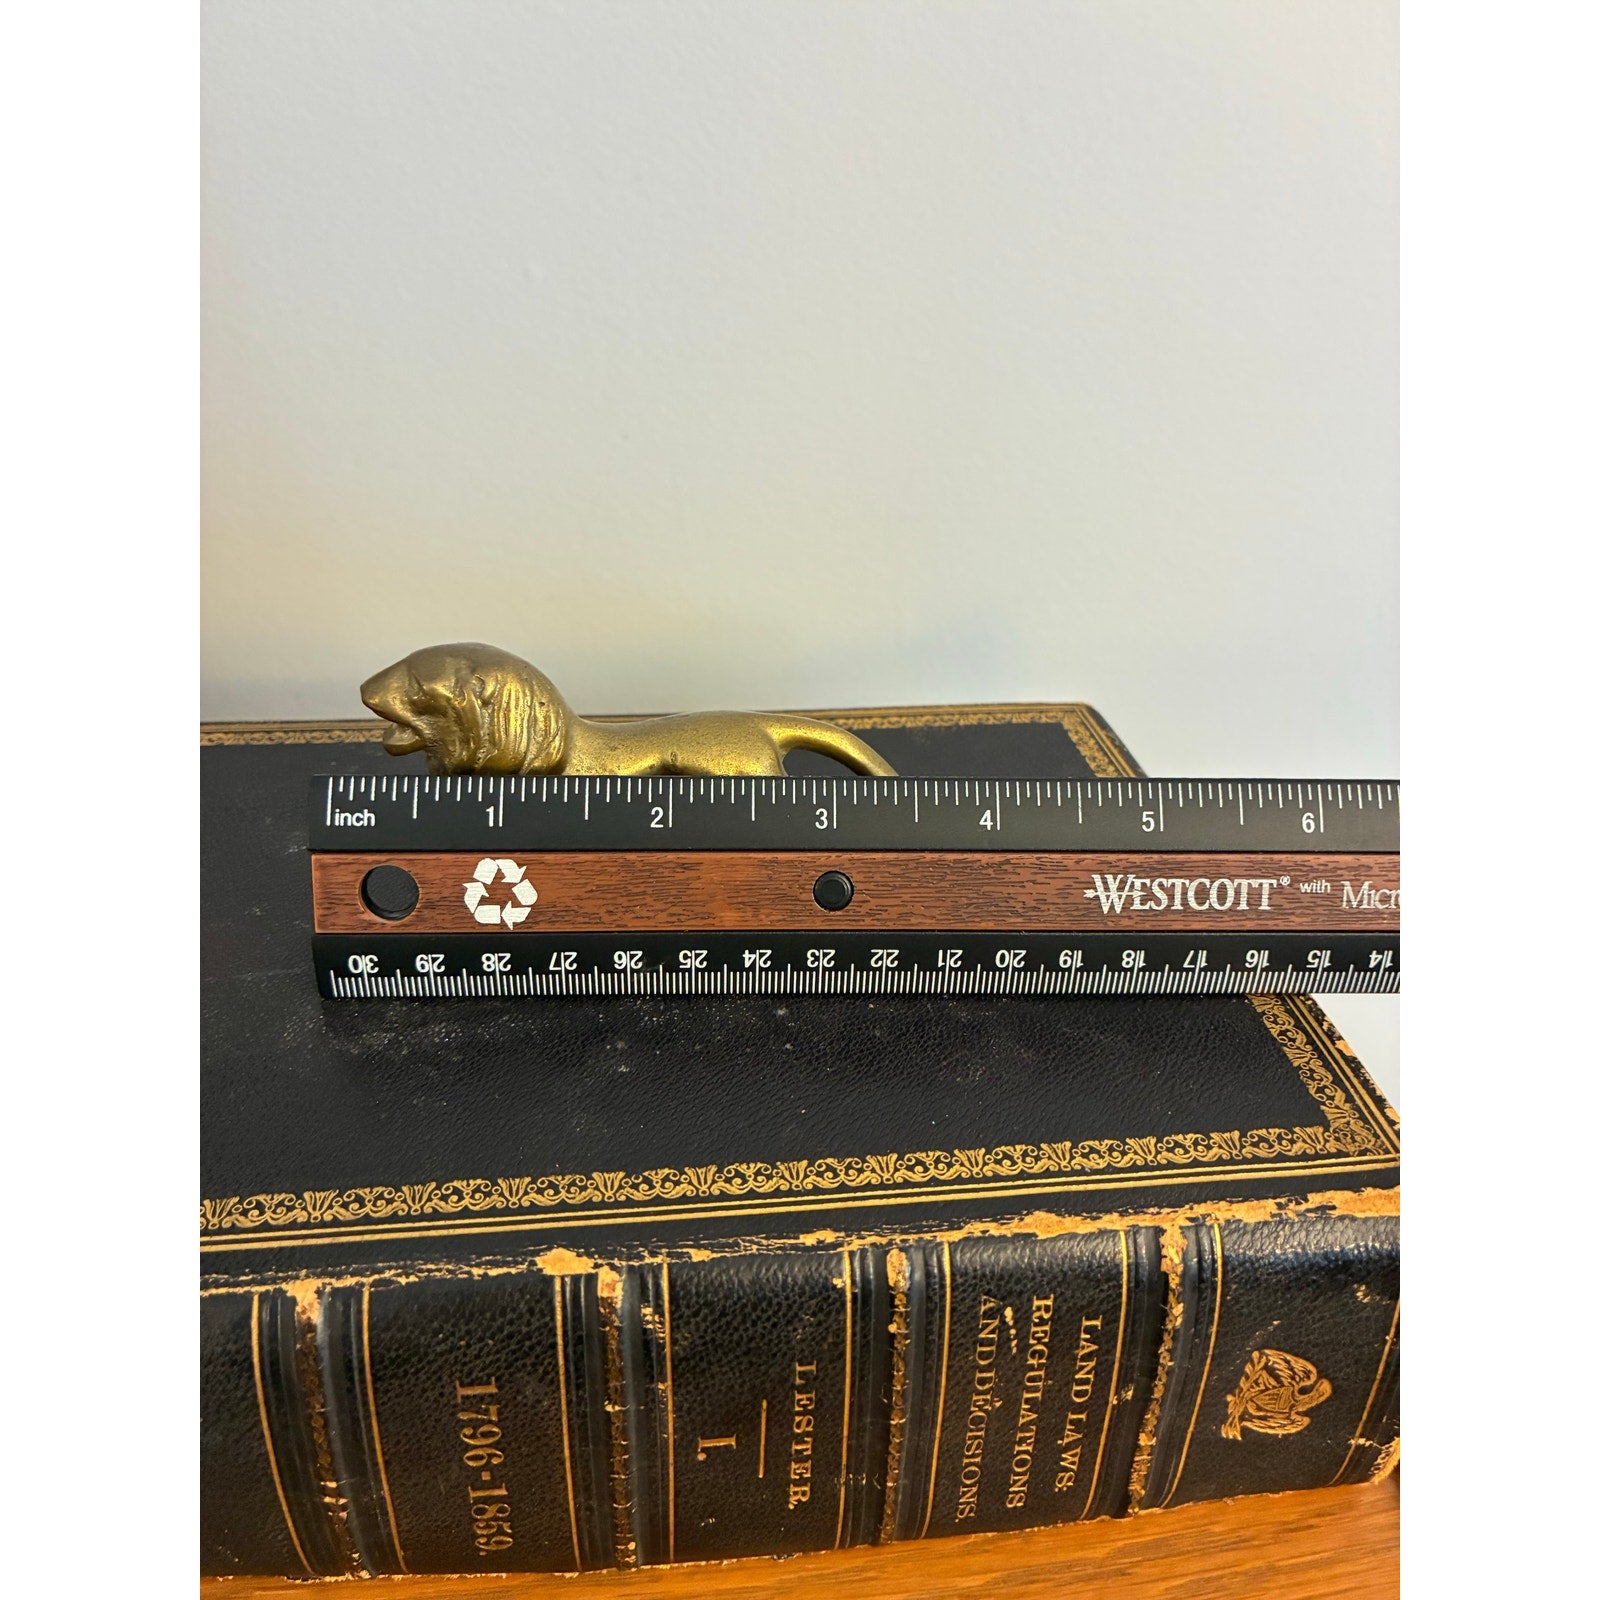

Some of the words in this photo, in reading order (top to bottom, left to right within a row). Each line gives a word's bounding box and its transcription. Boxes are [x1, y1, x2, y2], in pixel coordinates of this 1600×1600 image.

[334, 809, 376, 828] inch
[485, 807, 495, 827] 1
[650, 807, 665, 828] 2
[815, 808, 829, 829] 3
[979, 809, 993, 830] 4
[1141, 811, 1155, 832] 5
[1301, 812, 1315, 833] 6
[1299, 879, 1331, 894] with
[1340, 880, 1400, 909] Micr
[348, 954, 379, 974] 30
[415, 953, 445, 973] 29
[481, 953, 511, 972] 28
[549, 951, 577, 970] 27
[613, 951, 642, 969] 26
[679, 949, 707, 968] 25
[742, 949, 772, 968] 24
[806, 949, 835, 968] 23
[870, 949, 899, 967] 22
[937, 949, 962, 967] 21
[995, 949, 1026, 967] 20
[1059, 949, 1083, 968] 19
[1121, 949, 1146, 968] 18
[1183, 950, 1207, 968] 17
[1245, 950, 1269, 968] 16
[1306, 950, 1331, 969] 15
[1369, 950, 1393, 969] 14
[975, 1294, 1002, 1367] AND
[1070, 1314, 1103, 1404] LAND
[1005, 1293, 1055, 1509] REGULATIONS
[787, 1359, 818, 1511] LESTER.
[955, 1367, 998, 1523] DECISIONS.
